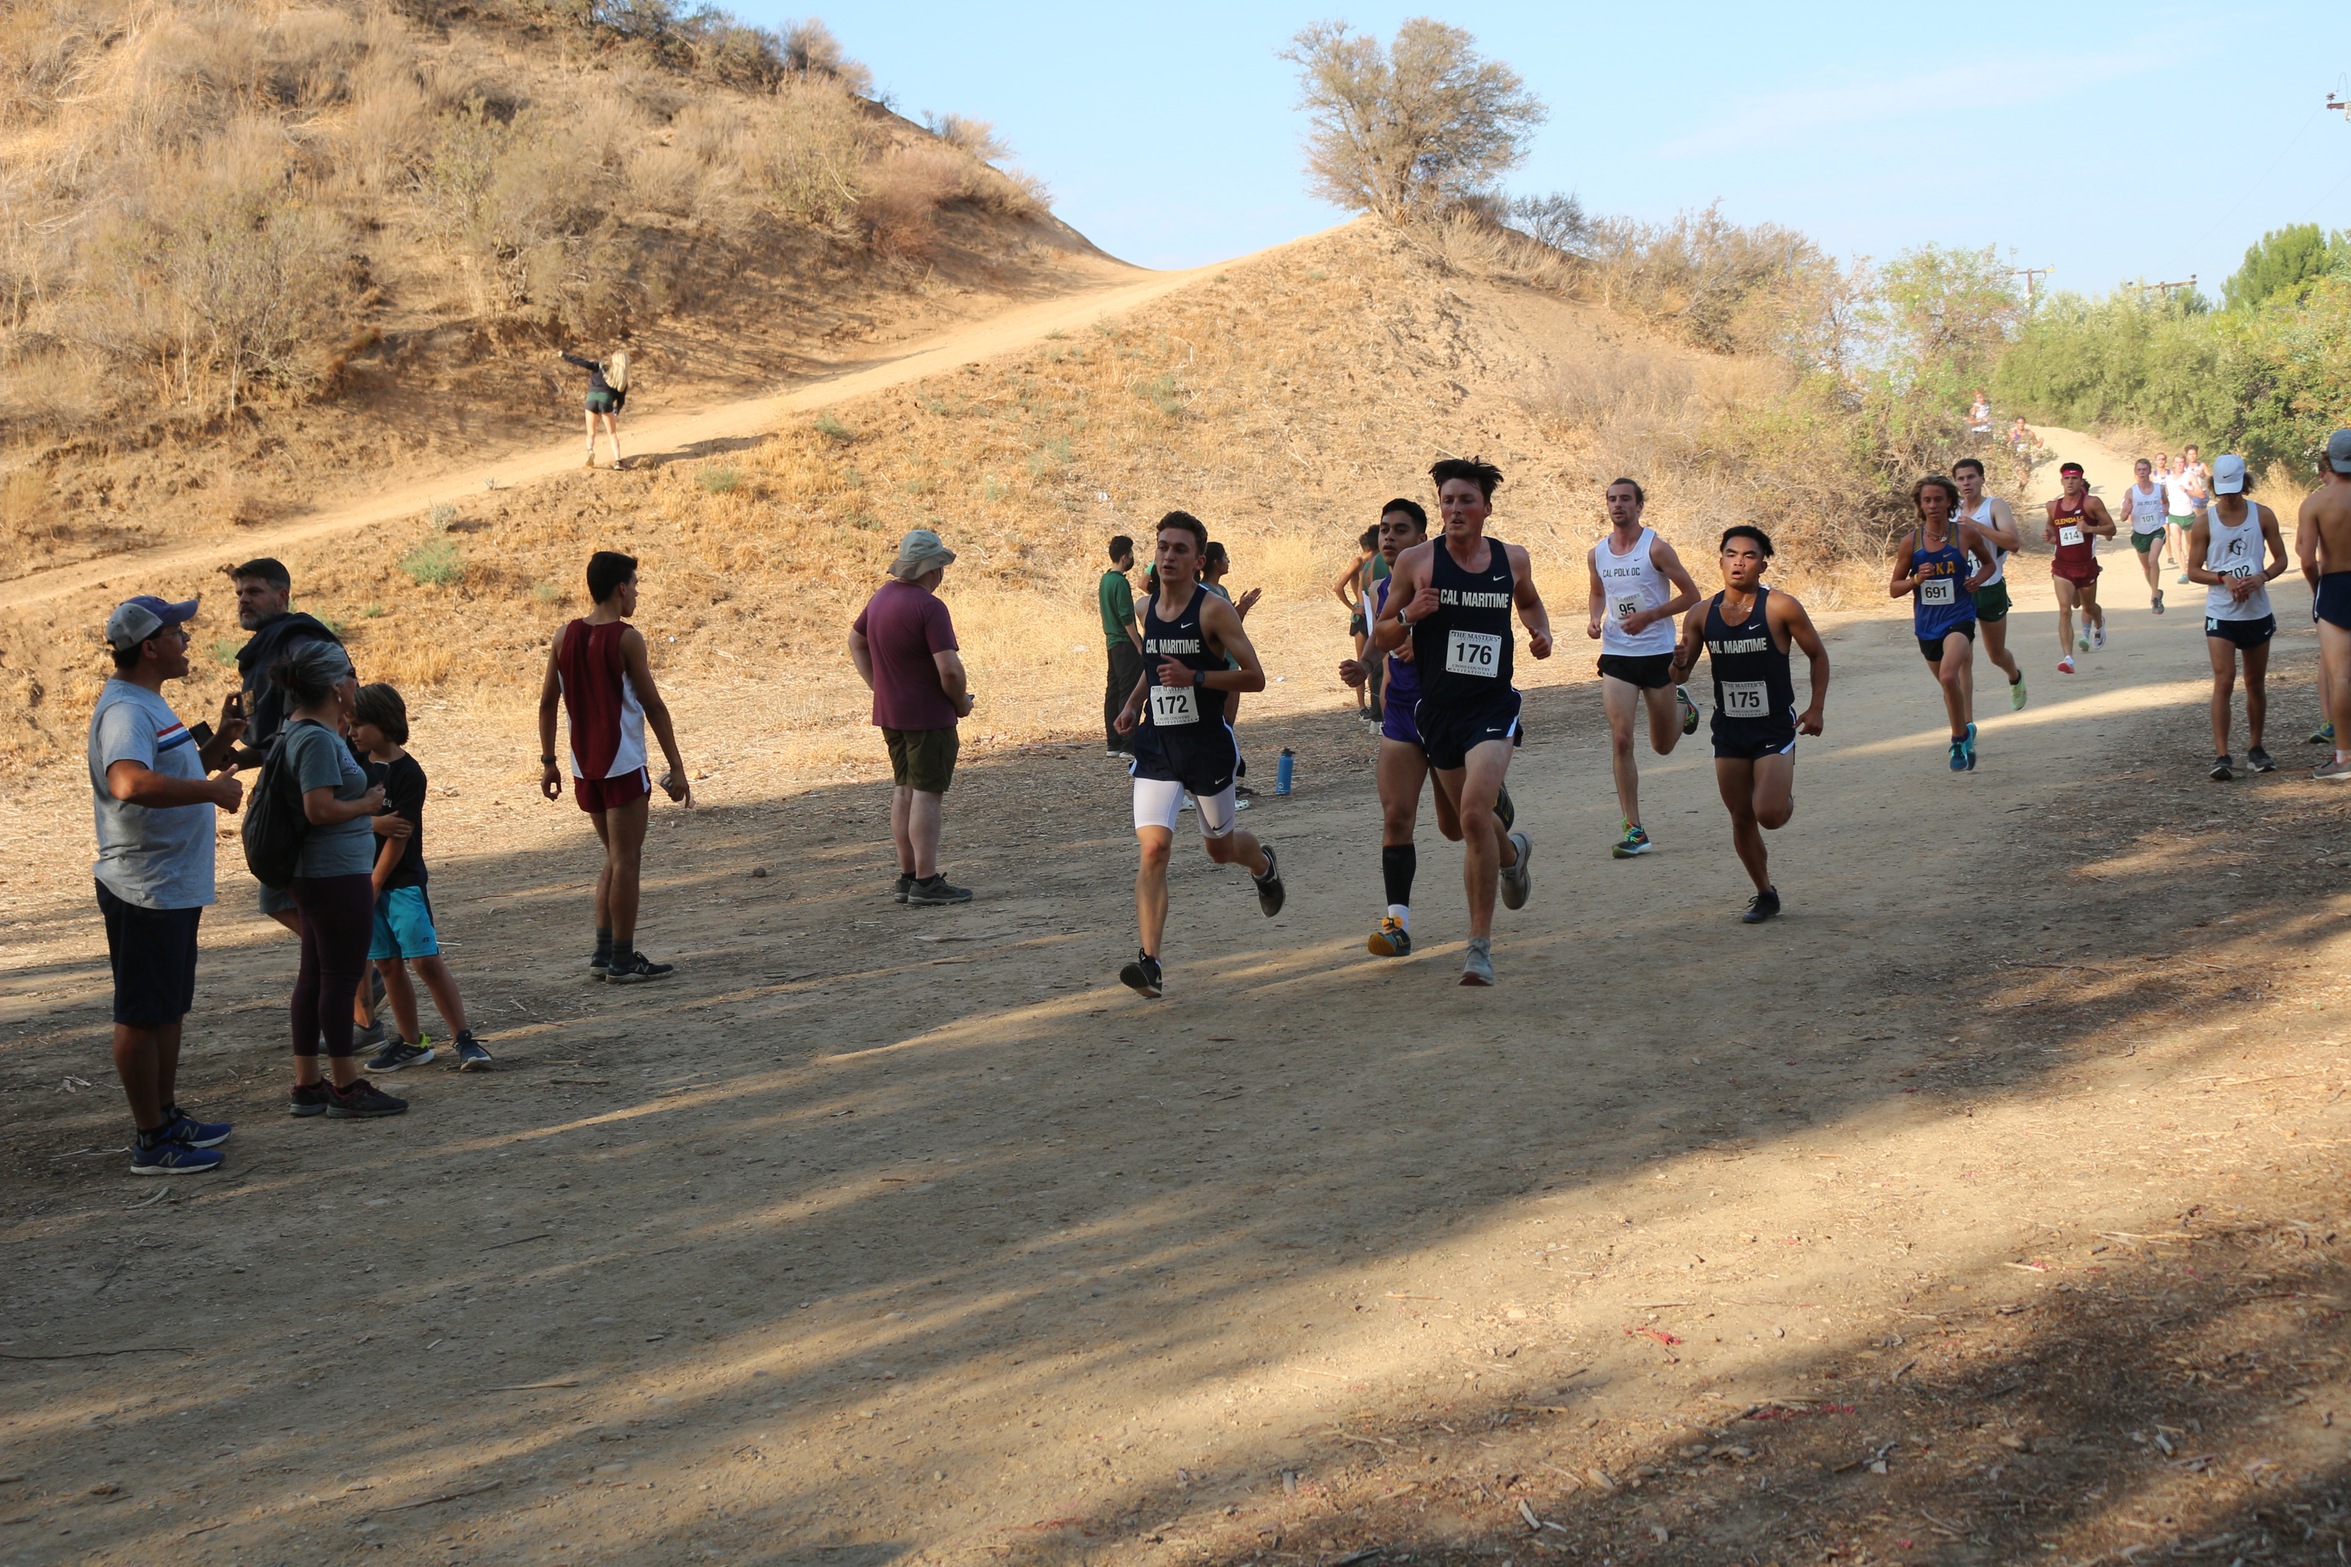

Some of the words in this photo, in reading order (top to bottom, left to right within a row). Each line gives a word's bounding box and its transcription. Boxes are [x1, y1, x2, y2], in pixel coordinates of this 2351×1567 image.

[2063, 531, 2079, 540] 414
[1603, 570, 1612, 578] CAL
[1614, 568, 1630, 576] POLY
[1440, 589, 1458, 605] CAL
[1462, 592, 1509, 608] MARITIME
[1925, 586, 1947, 599] 691
[1619, 602, 1636, 616] 95
[2207, 619, 2218, 631] M
[1146, 639, 1158, 654] CAL
[1160, 639, 1200, 654] MARITIME
[1708, 640, 1722, 654] CAL
[1723, 637, 1767, 654] MARITIME
[1456, 642, 1493, 666] 176
[1156, 695, 1189, 715] 172
[1728, 691, 1761, 708] 175
